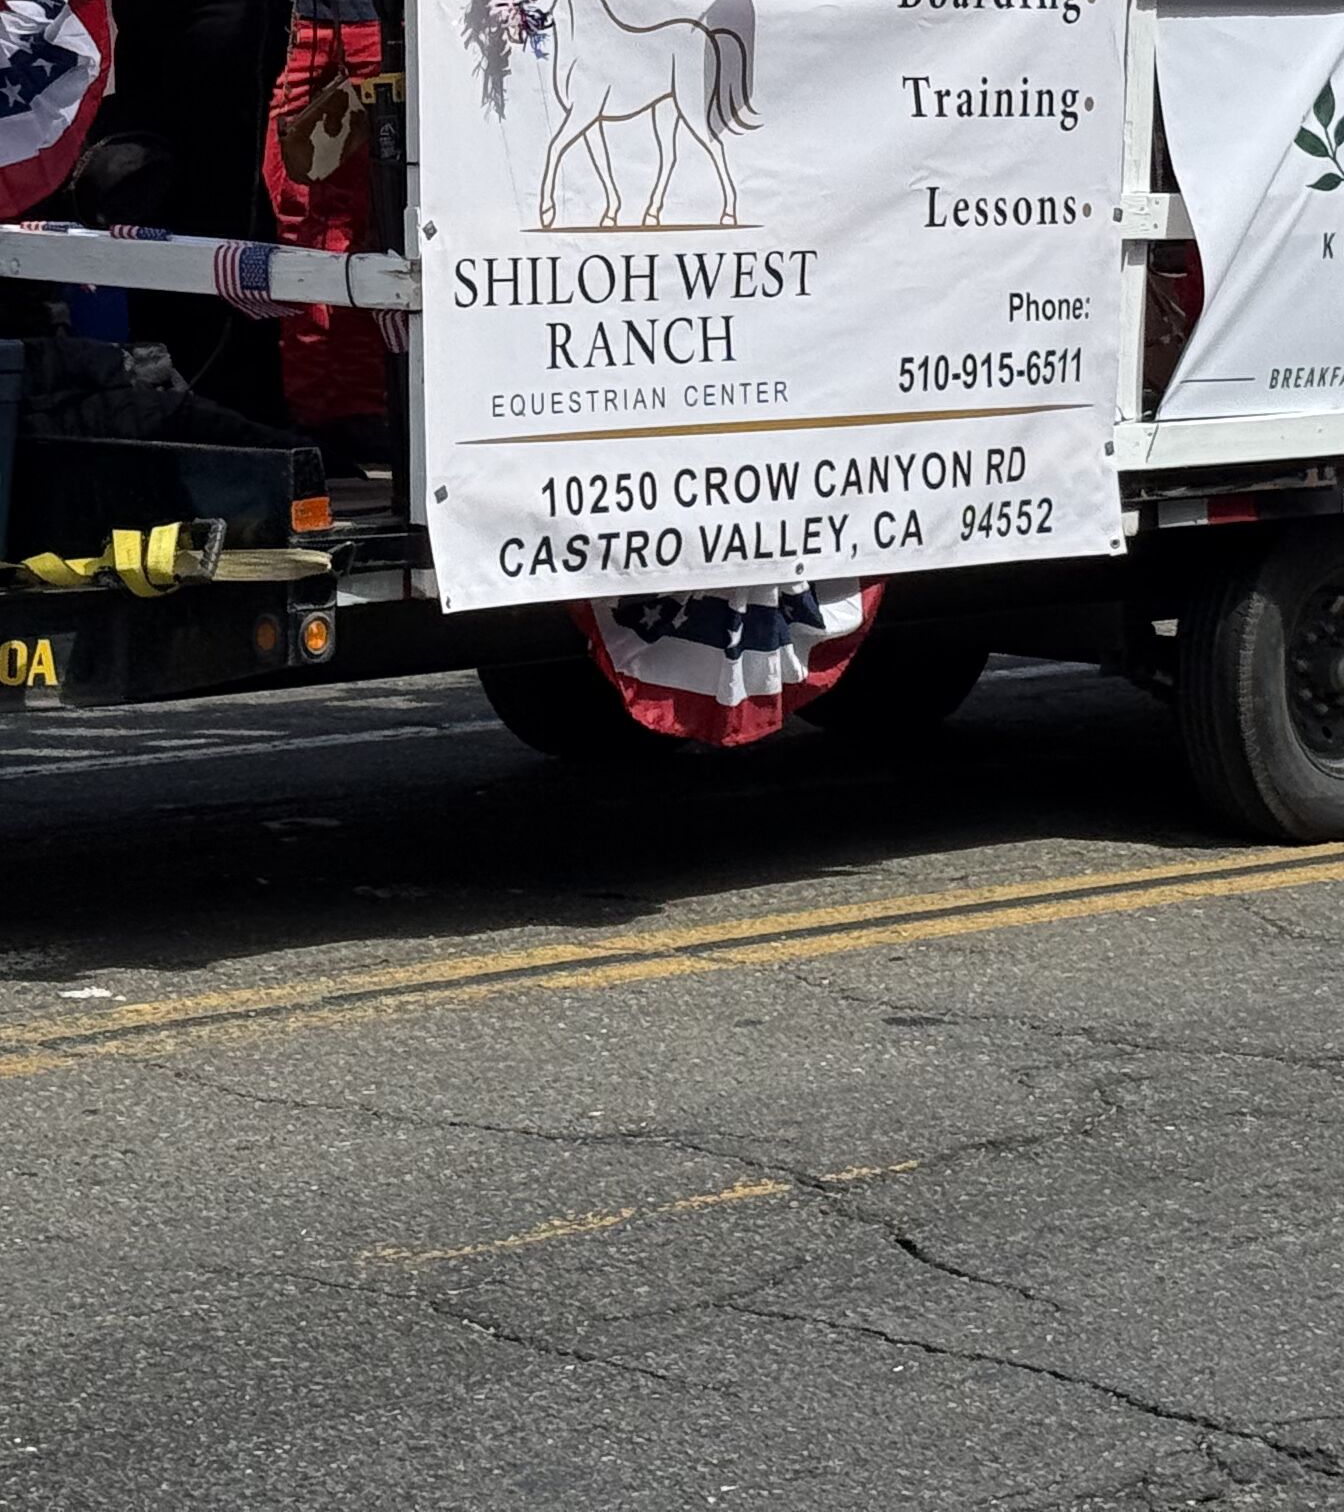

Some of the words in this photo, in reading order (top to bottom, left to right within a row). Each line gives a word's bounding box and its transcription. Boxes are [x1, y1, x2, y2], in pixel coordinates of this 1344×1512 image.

[903, 76, 1079, 131] Training
[925, 187, 1076, 227] Lessons
[455, 254, 659, 308] SHILOH
[675, 251, 817, 300] WEST
[1010, 292, 1089, 322] Phone:
[546, 316, 736, 369] RANCH
[899, 348, 1081, 393] 510-915-6511
[492, 387, 665, 417] EQUESTRIAN
[684, 381, 788, 407] CENTER
[542, 472, 657, 517] 10250
[674, 462, 799, 507] CROW
[815, 450, 971, 498] CANYON
[986, 447, 1025, 485] RD
[500, 528, 682, 577] CASTRO
[699, 514, 857, 563] VALLEY,
[874, 510, 923, 549] CA
[961, 498, 1052, 541] 94552
